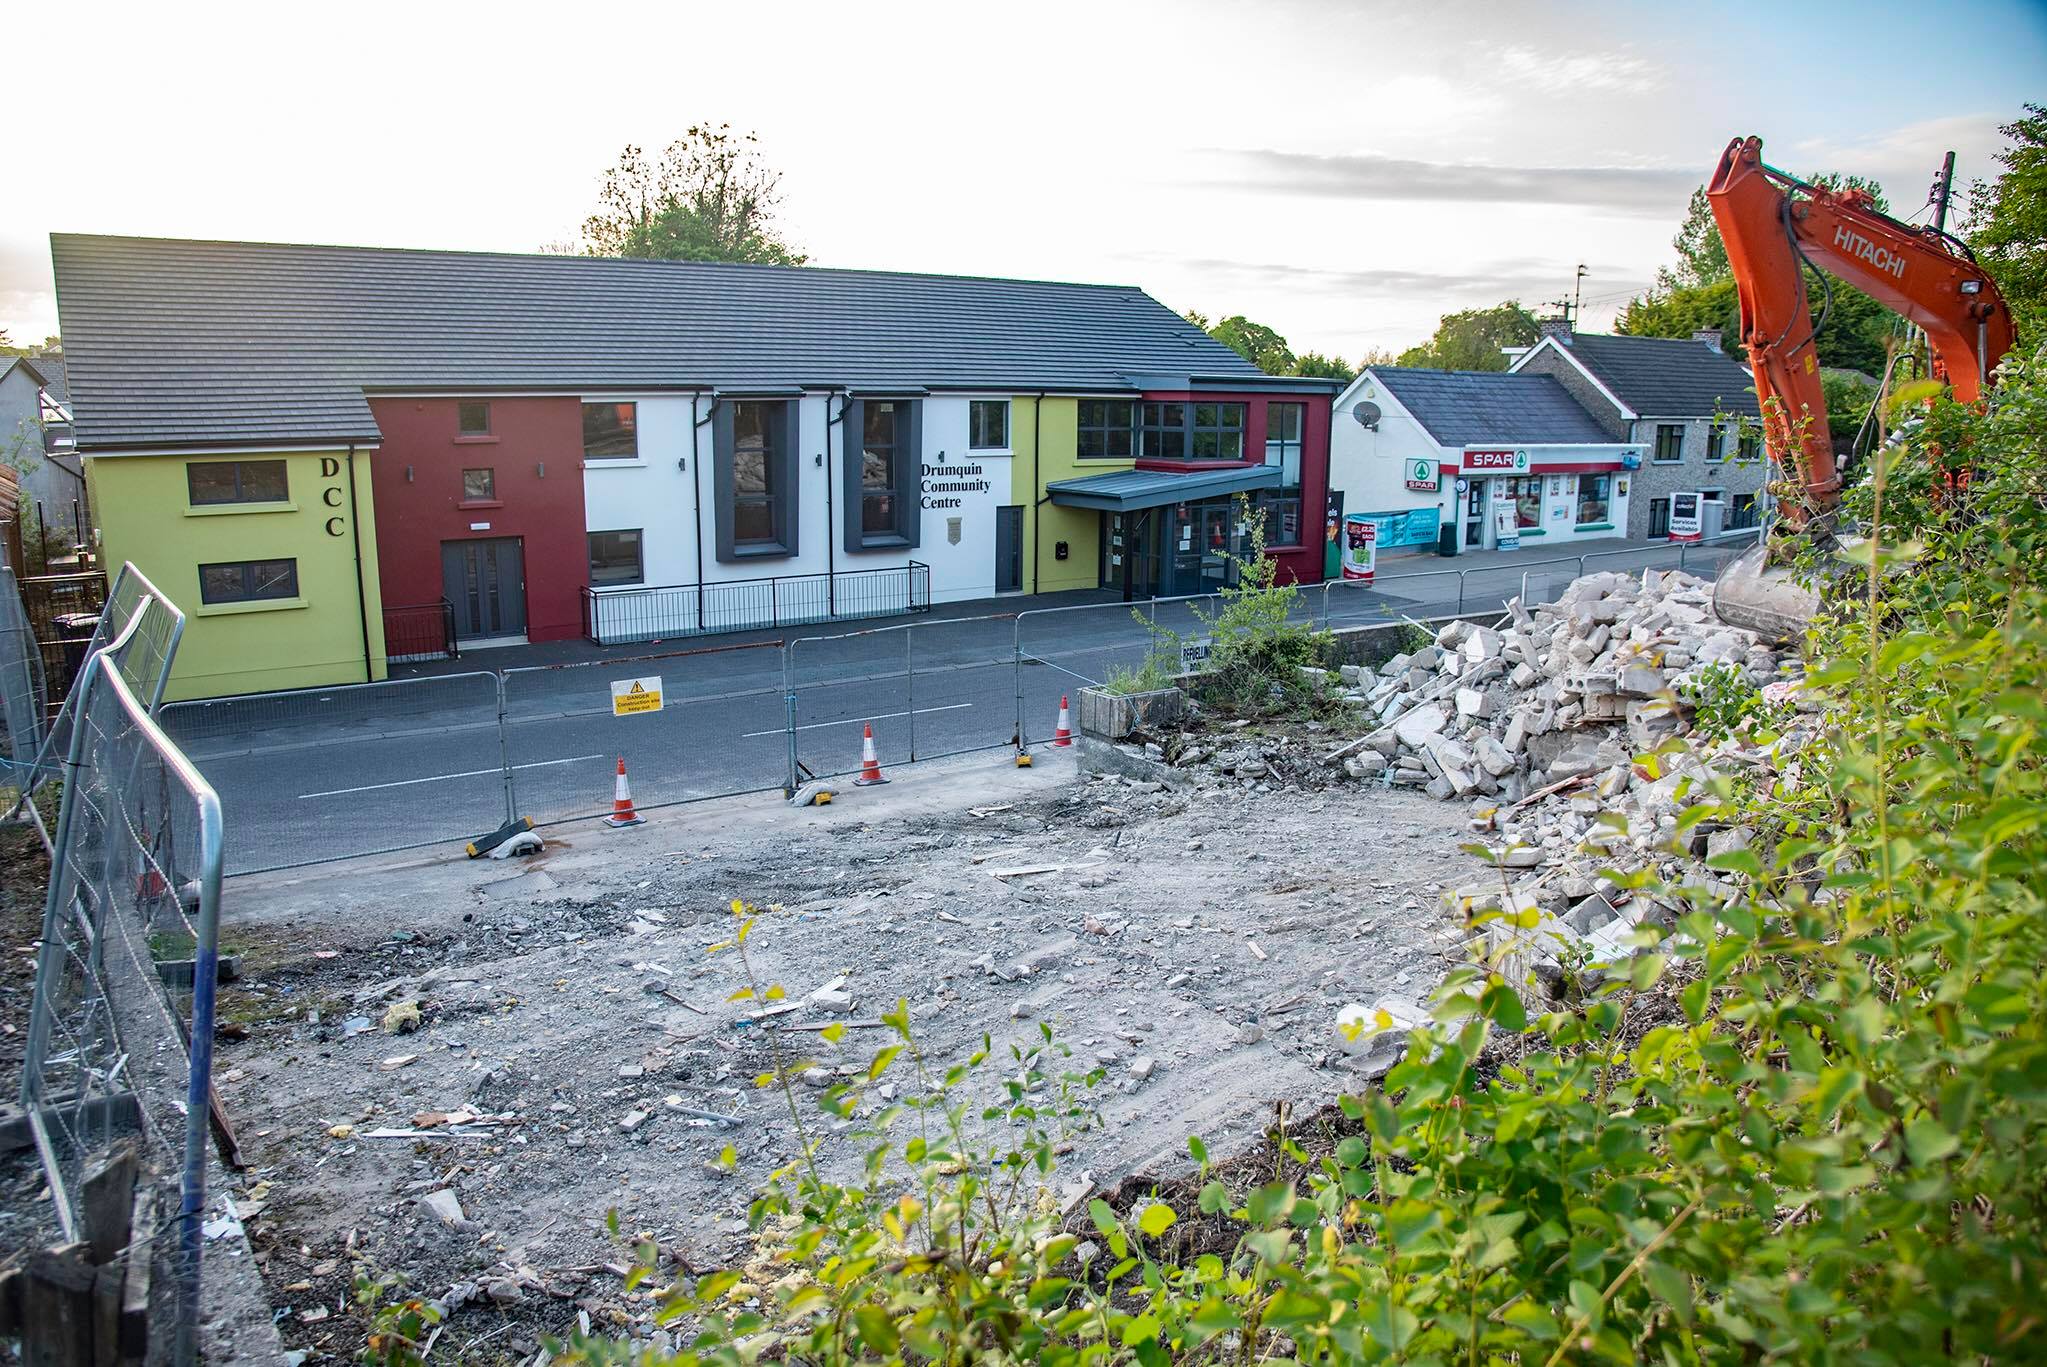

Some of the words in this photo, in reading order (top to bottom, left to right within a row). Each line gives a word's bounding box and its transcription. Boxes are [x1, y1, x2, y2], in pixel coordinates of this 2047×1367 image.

[1834, 225, 1906, 279] HITACHI
[1473, 454, 1513, 466] SPAR
[921, 462, 982, 478] Drumquin
[921, 479, 992, 494] Community
[1408, 481, 1434, 489] SPAR
[921, 496, 961, 509] Centre
[1183, 646, 1211, 661] REFUELLIN
[627, 693, 649, 701] DANGER
